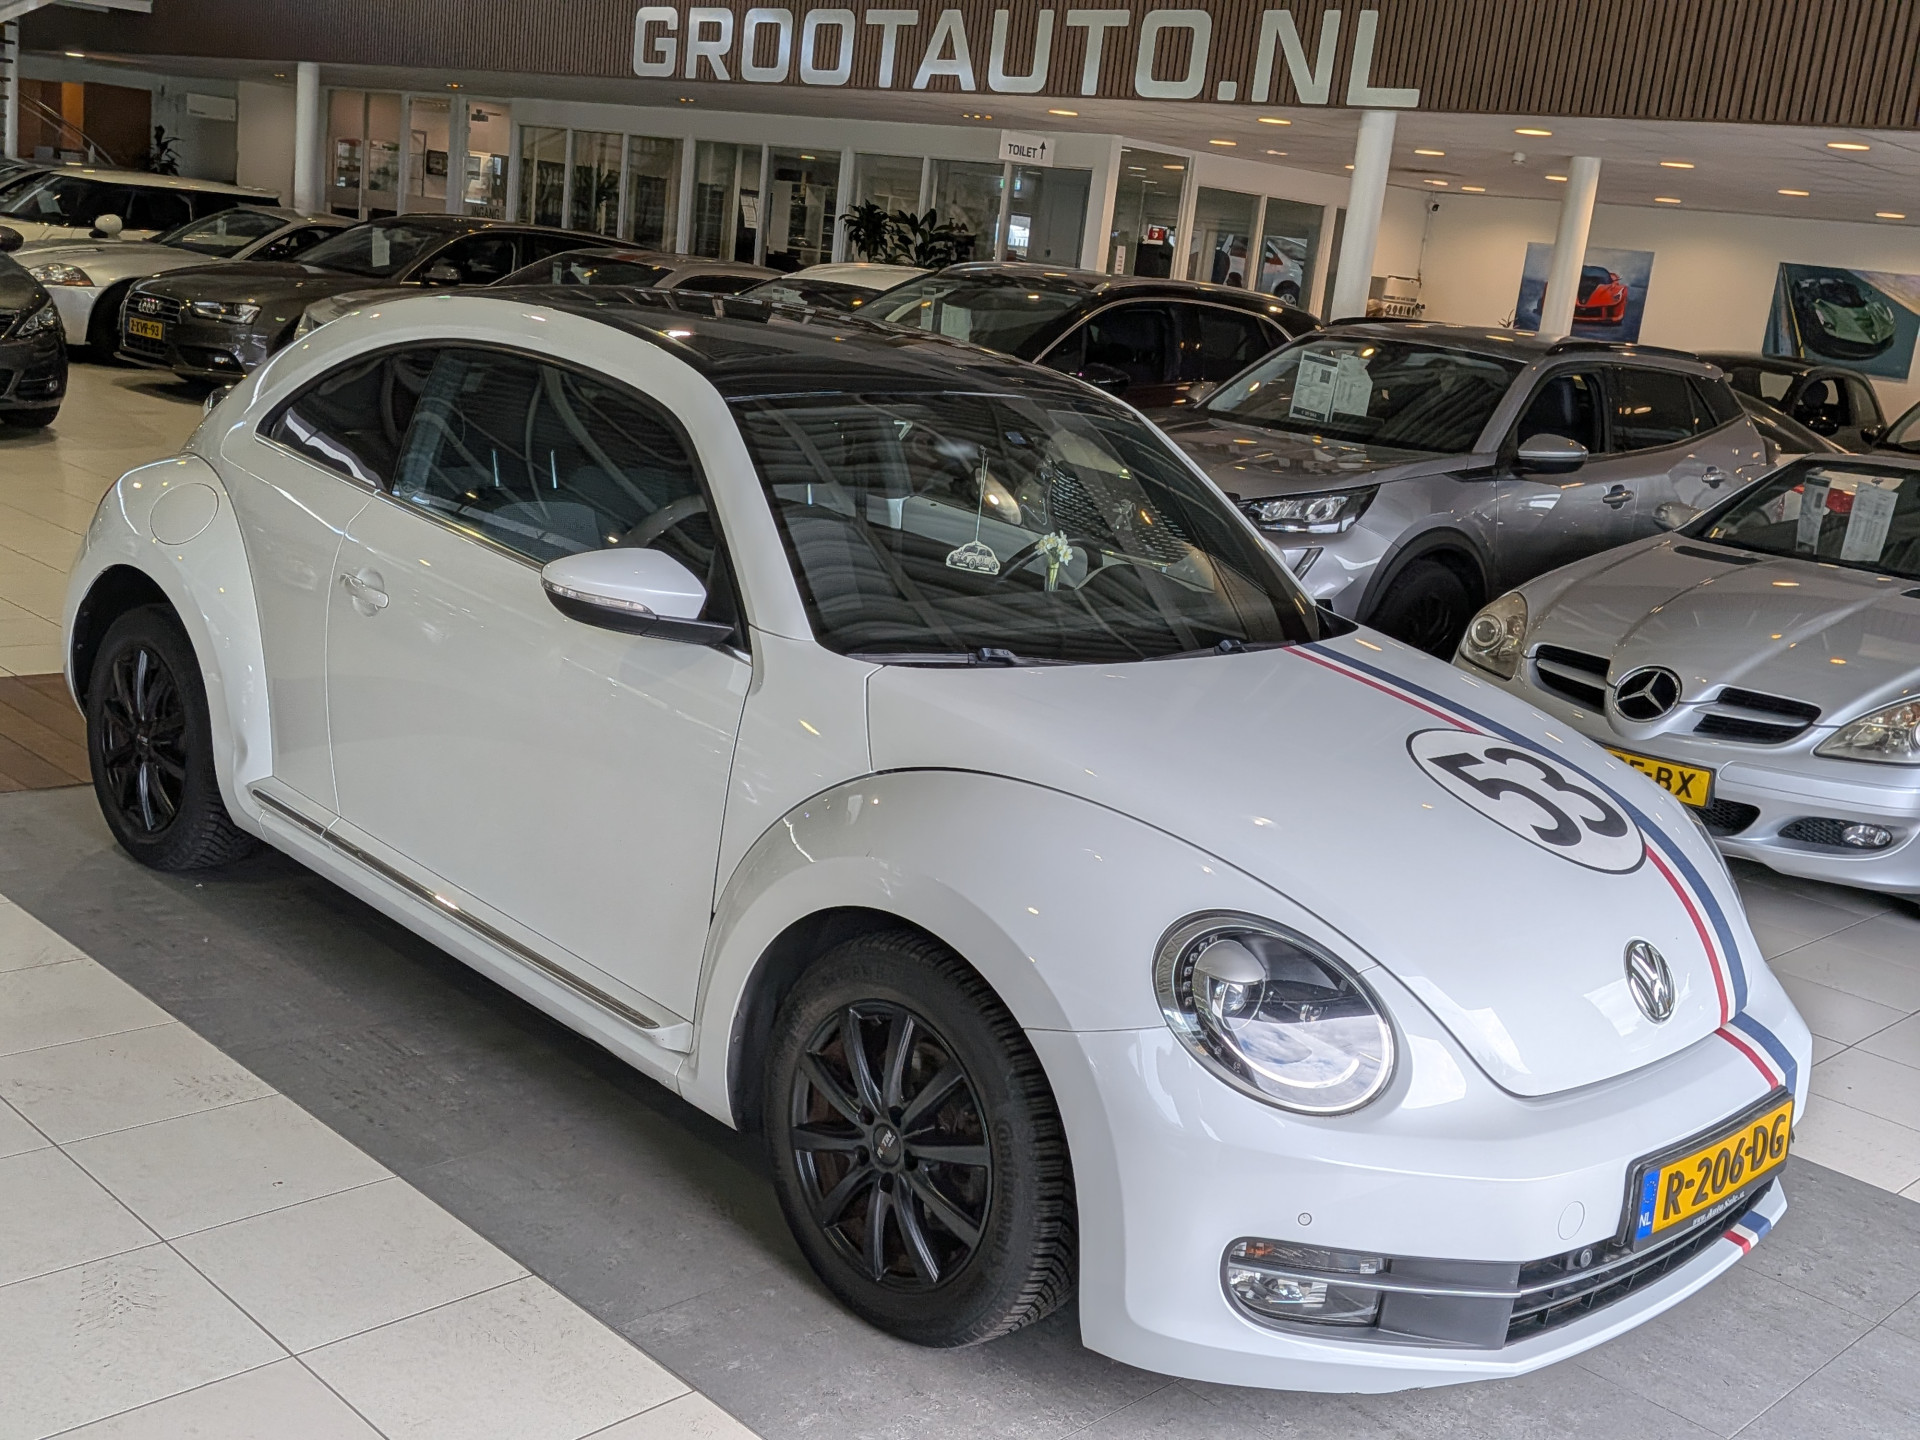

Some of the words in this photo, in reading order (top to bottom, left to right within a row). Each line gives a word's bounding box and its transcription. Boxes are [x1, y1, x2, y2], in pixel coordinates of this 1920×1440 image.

[633, 6, 1420, 108] GROOTAUTO.NL
[1008, 143, 1038, 159] TOILET
[1427, 747, 1628, 847] 53
[1662, 1113, 1787, 1221] R-206-DG
[1639, 1211, 1652, 1229] NL
